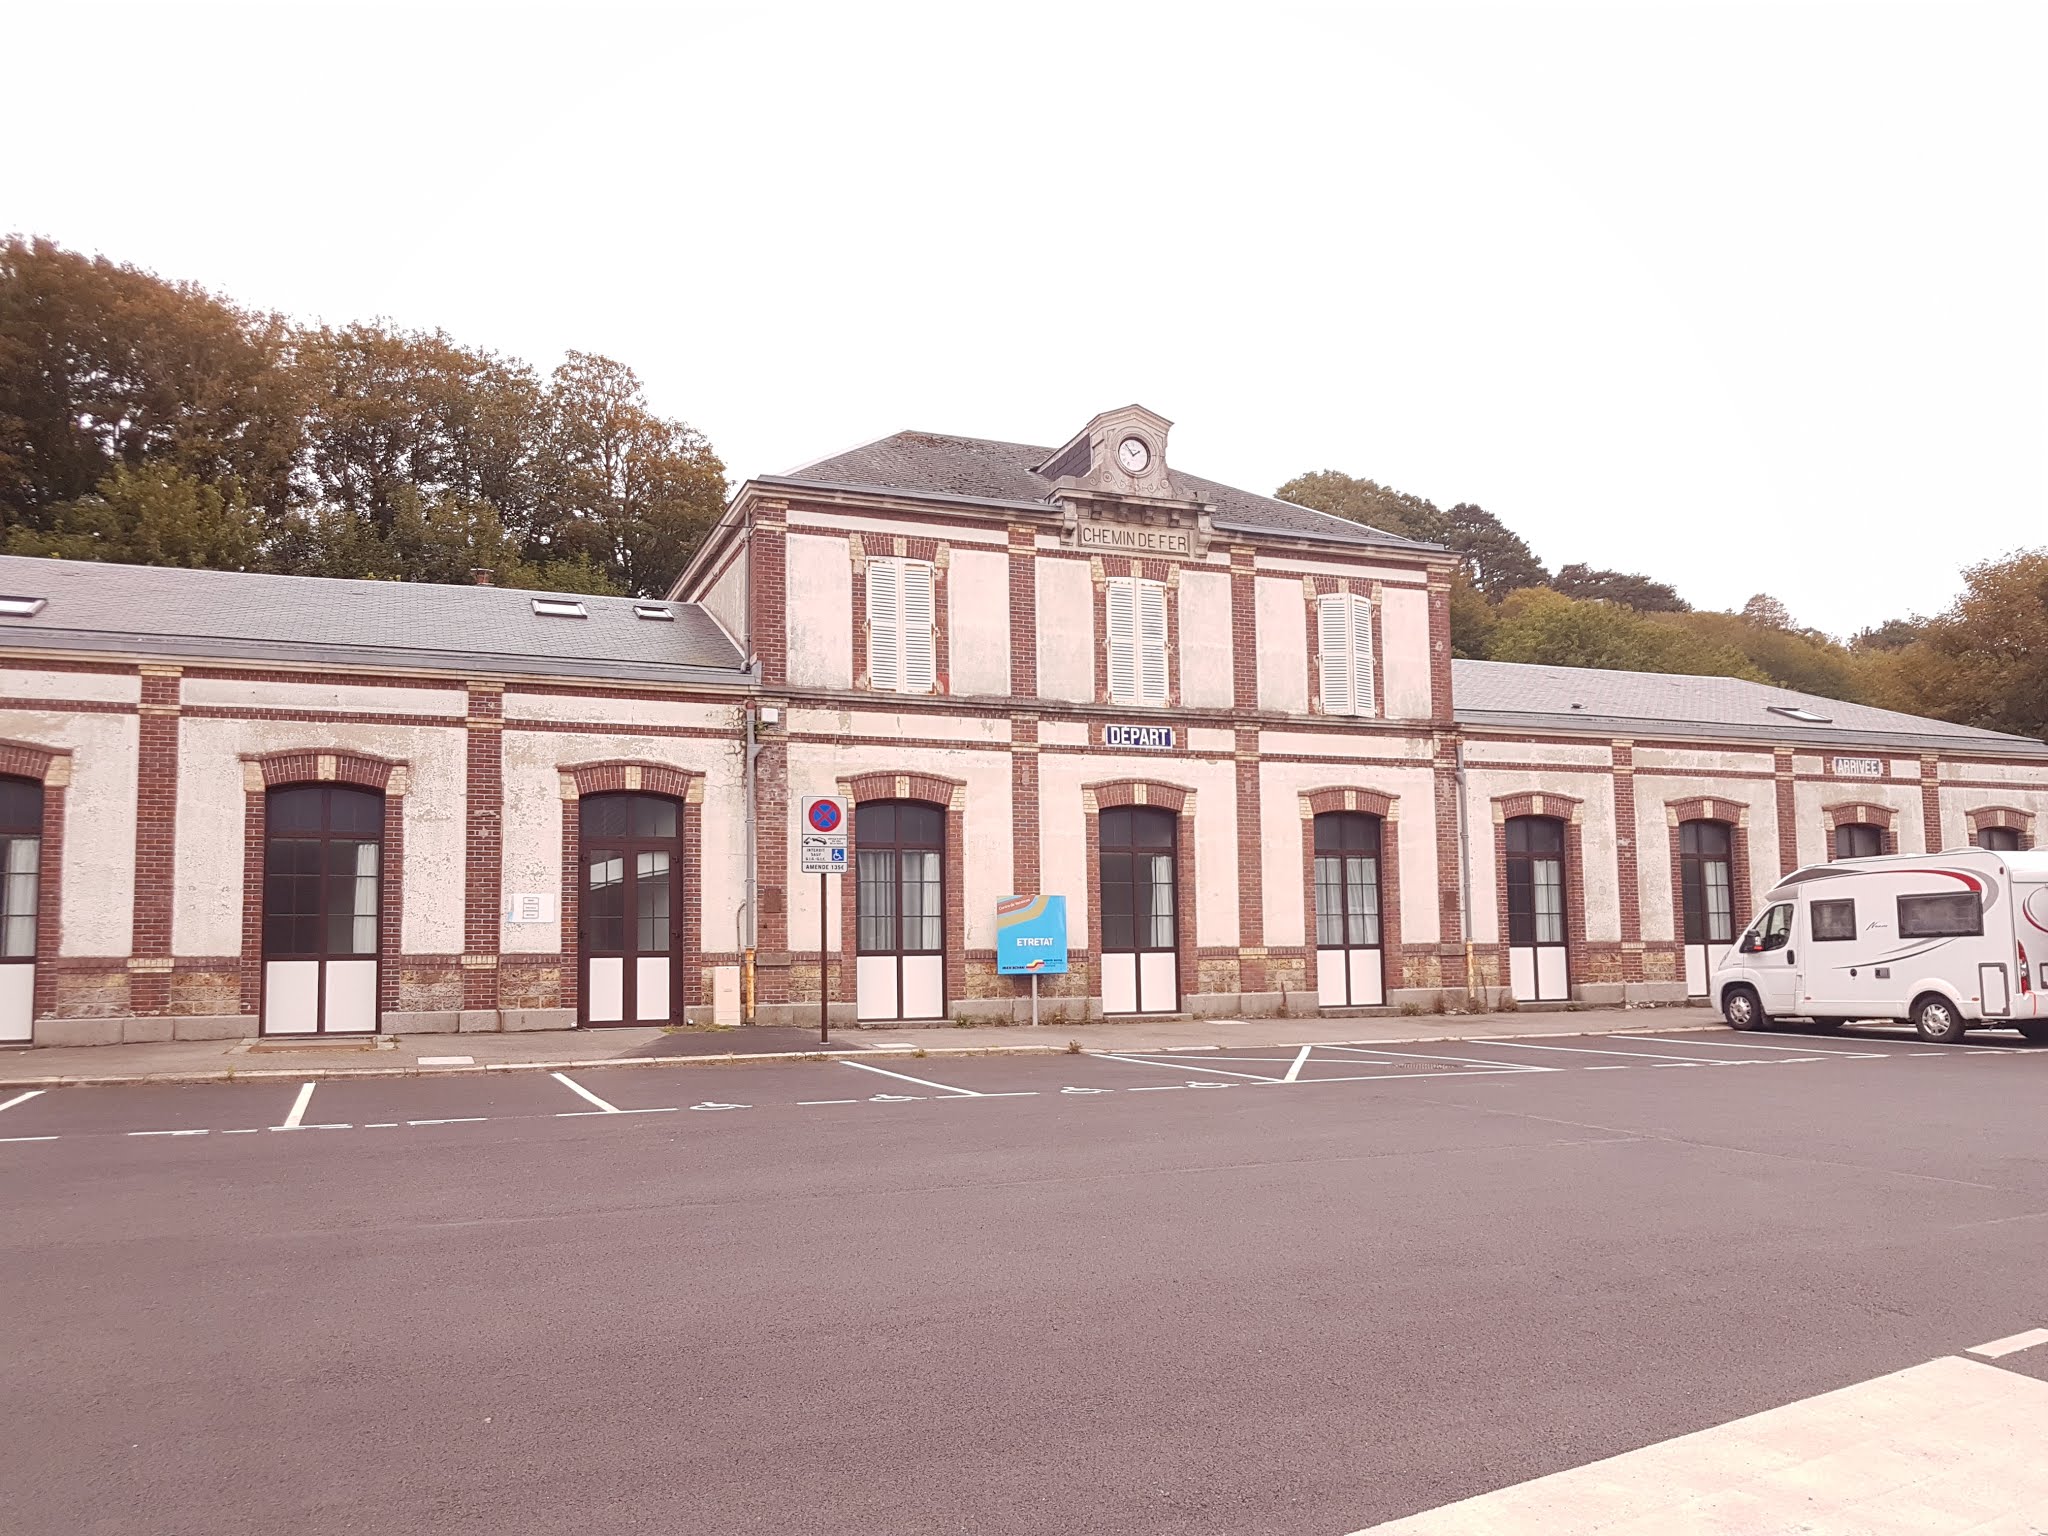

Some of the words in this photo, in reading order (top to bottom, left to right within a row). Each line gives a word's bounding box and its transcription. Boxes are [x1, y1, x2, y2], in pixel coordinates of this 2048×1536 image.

[1083, 527, 1135, 546] CHEMIN
[1138, 533, 1156, 548] DE
[1159, 535, 1187, 551] FER
[1016, 937, 1053, 947] ETRETAT
